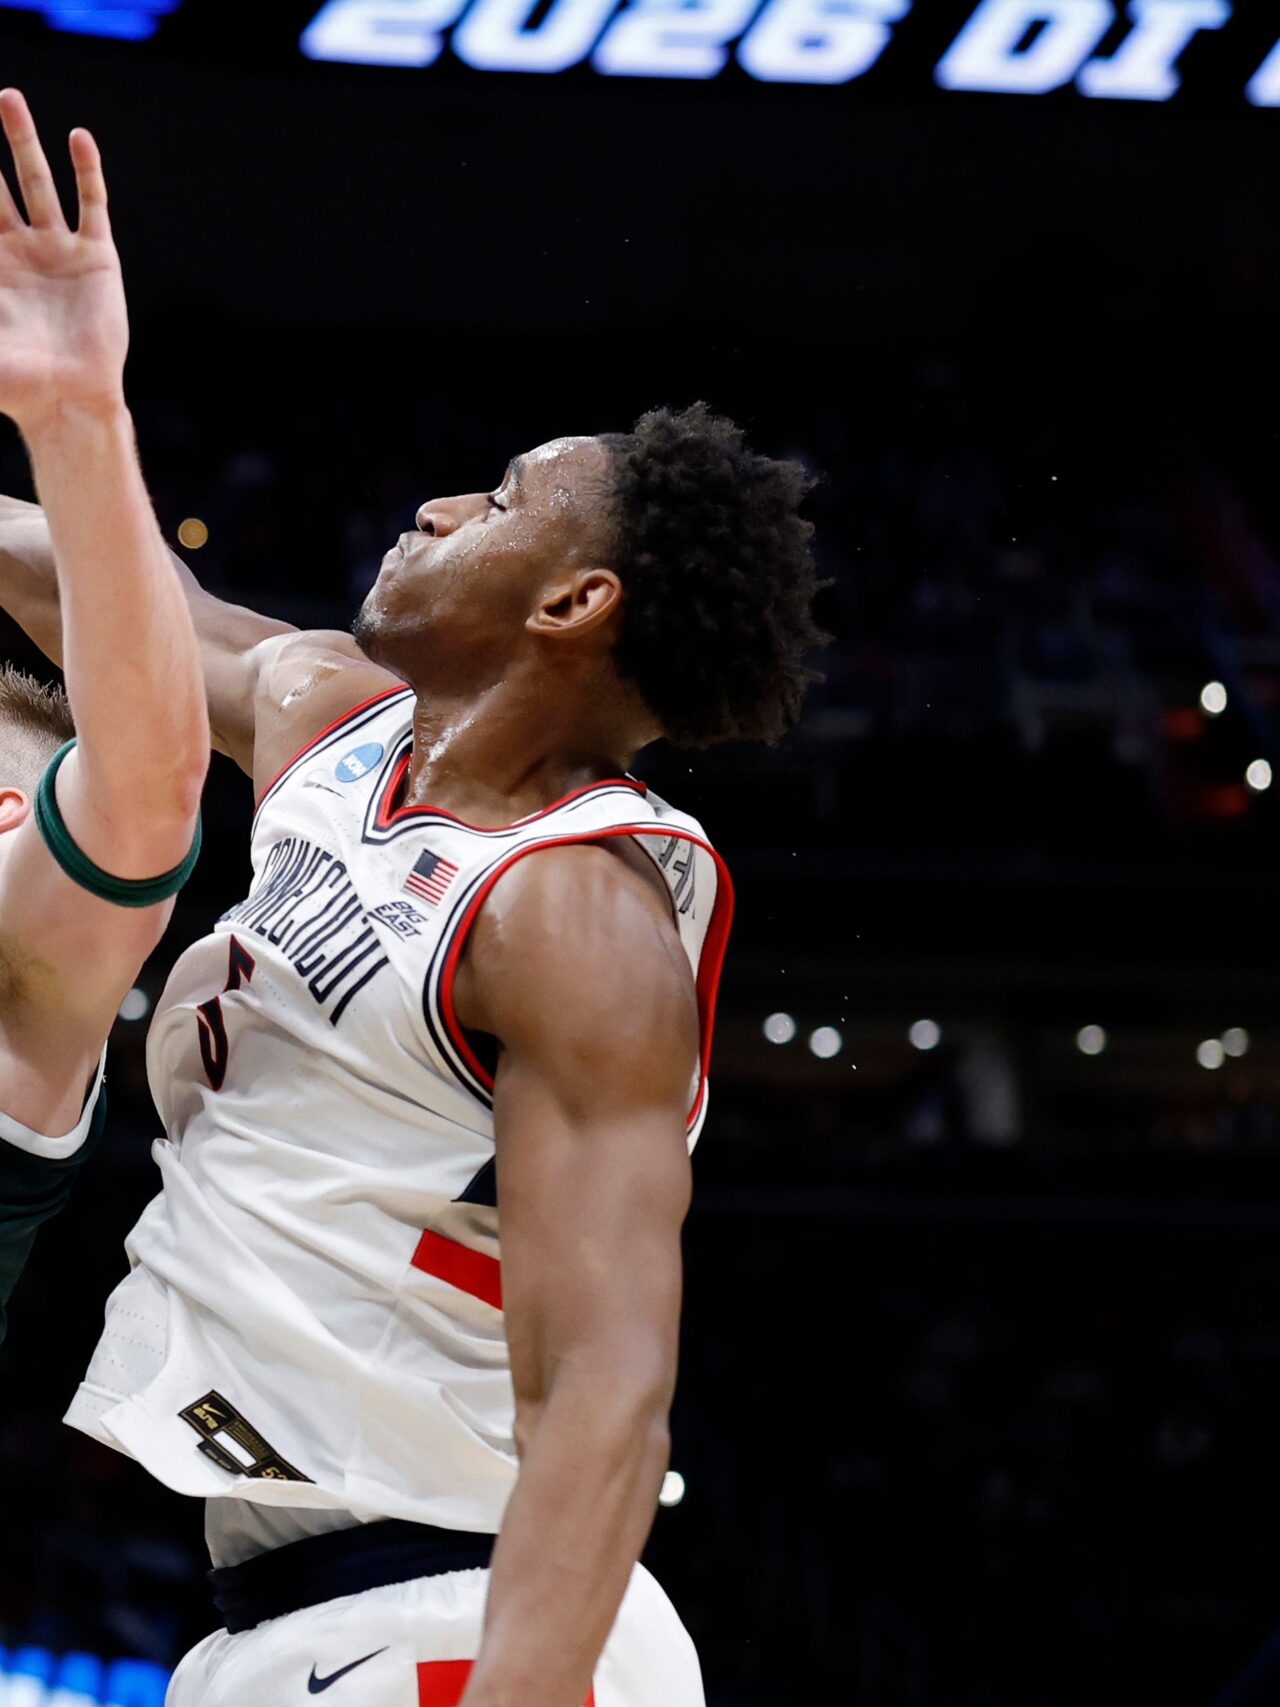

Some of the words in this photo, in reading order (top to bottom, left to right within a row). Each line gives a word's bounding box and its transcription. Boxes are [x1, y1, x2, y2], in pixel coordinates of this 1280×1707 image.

[300, 0, 915, 85] 2026
[933, 0, 1234, 102] DI
[374, 903, 423, 938] EAST
[390, 901, 429, 924] BIG
[196, 933, 256, 1092] 5
